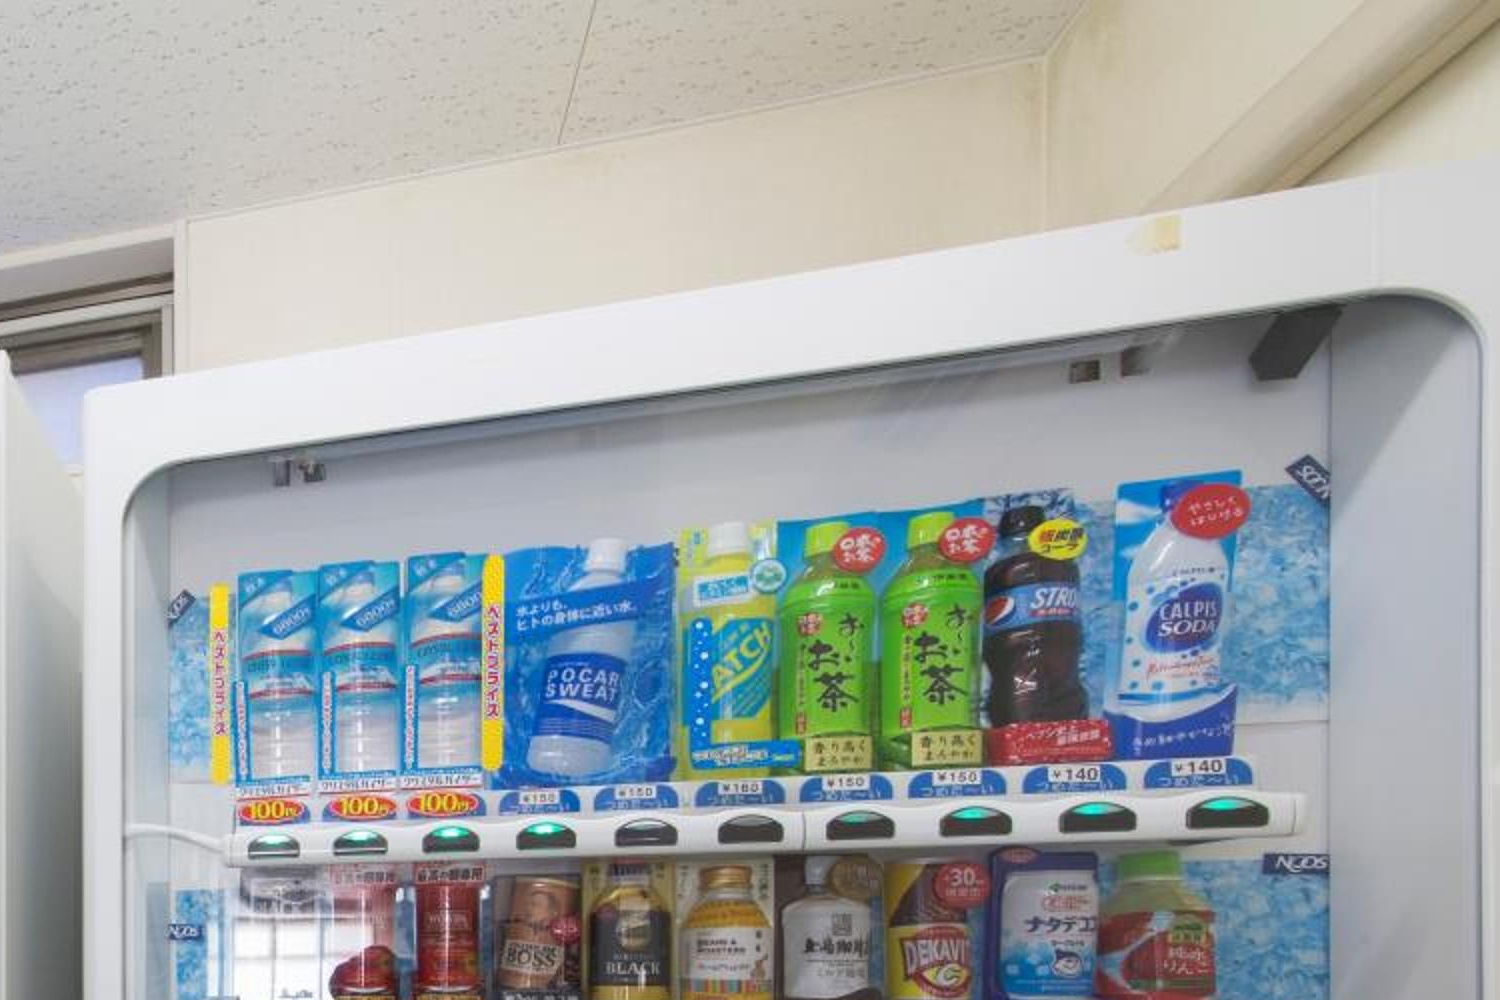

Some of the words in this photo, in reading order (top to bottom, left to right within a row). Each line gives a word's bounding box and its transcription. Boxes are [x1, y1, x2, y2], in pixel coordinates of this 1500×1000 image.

[1160, 600, 1217, 620] CALPIS
[1158, 618, 1215, 637] SODA
[712, 621, 770, 688] ATCH
[548, 668, 620, 684] POCAR
[808, 640, 860, 712] お茶
[914, 632, 968, 705] お茶
[546, 682, 619, 702] SWEAT
[1054, 768, 1099, 781] ¥140
[1175, 761, 1223, 773] ¥140
[607, 961, 661, 976] BLACK
